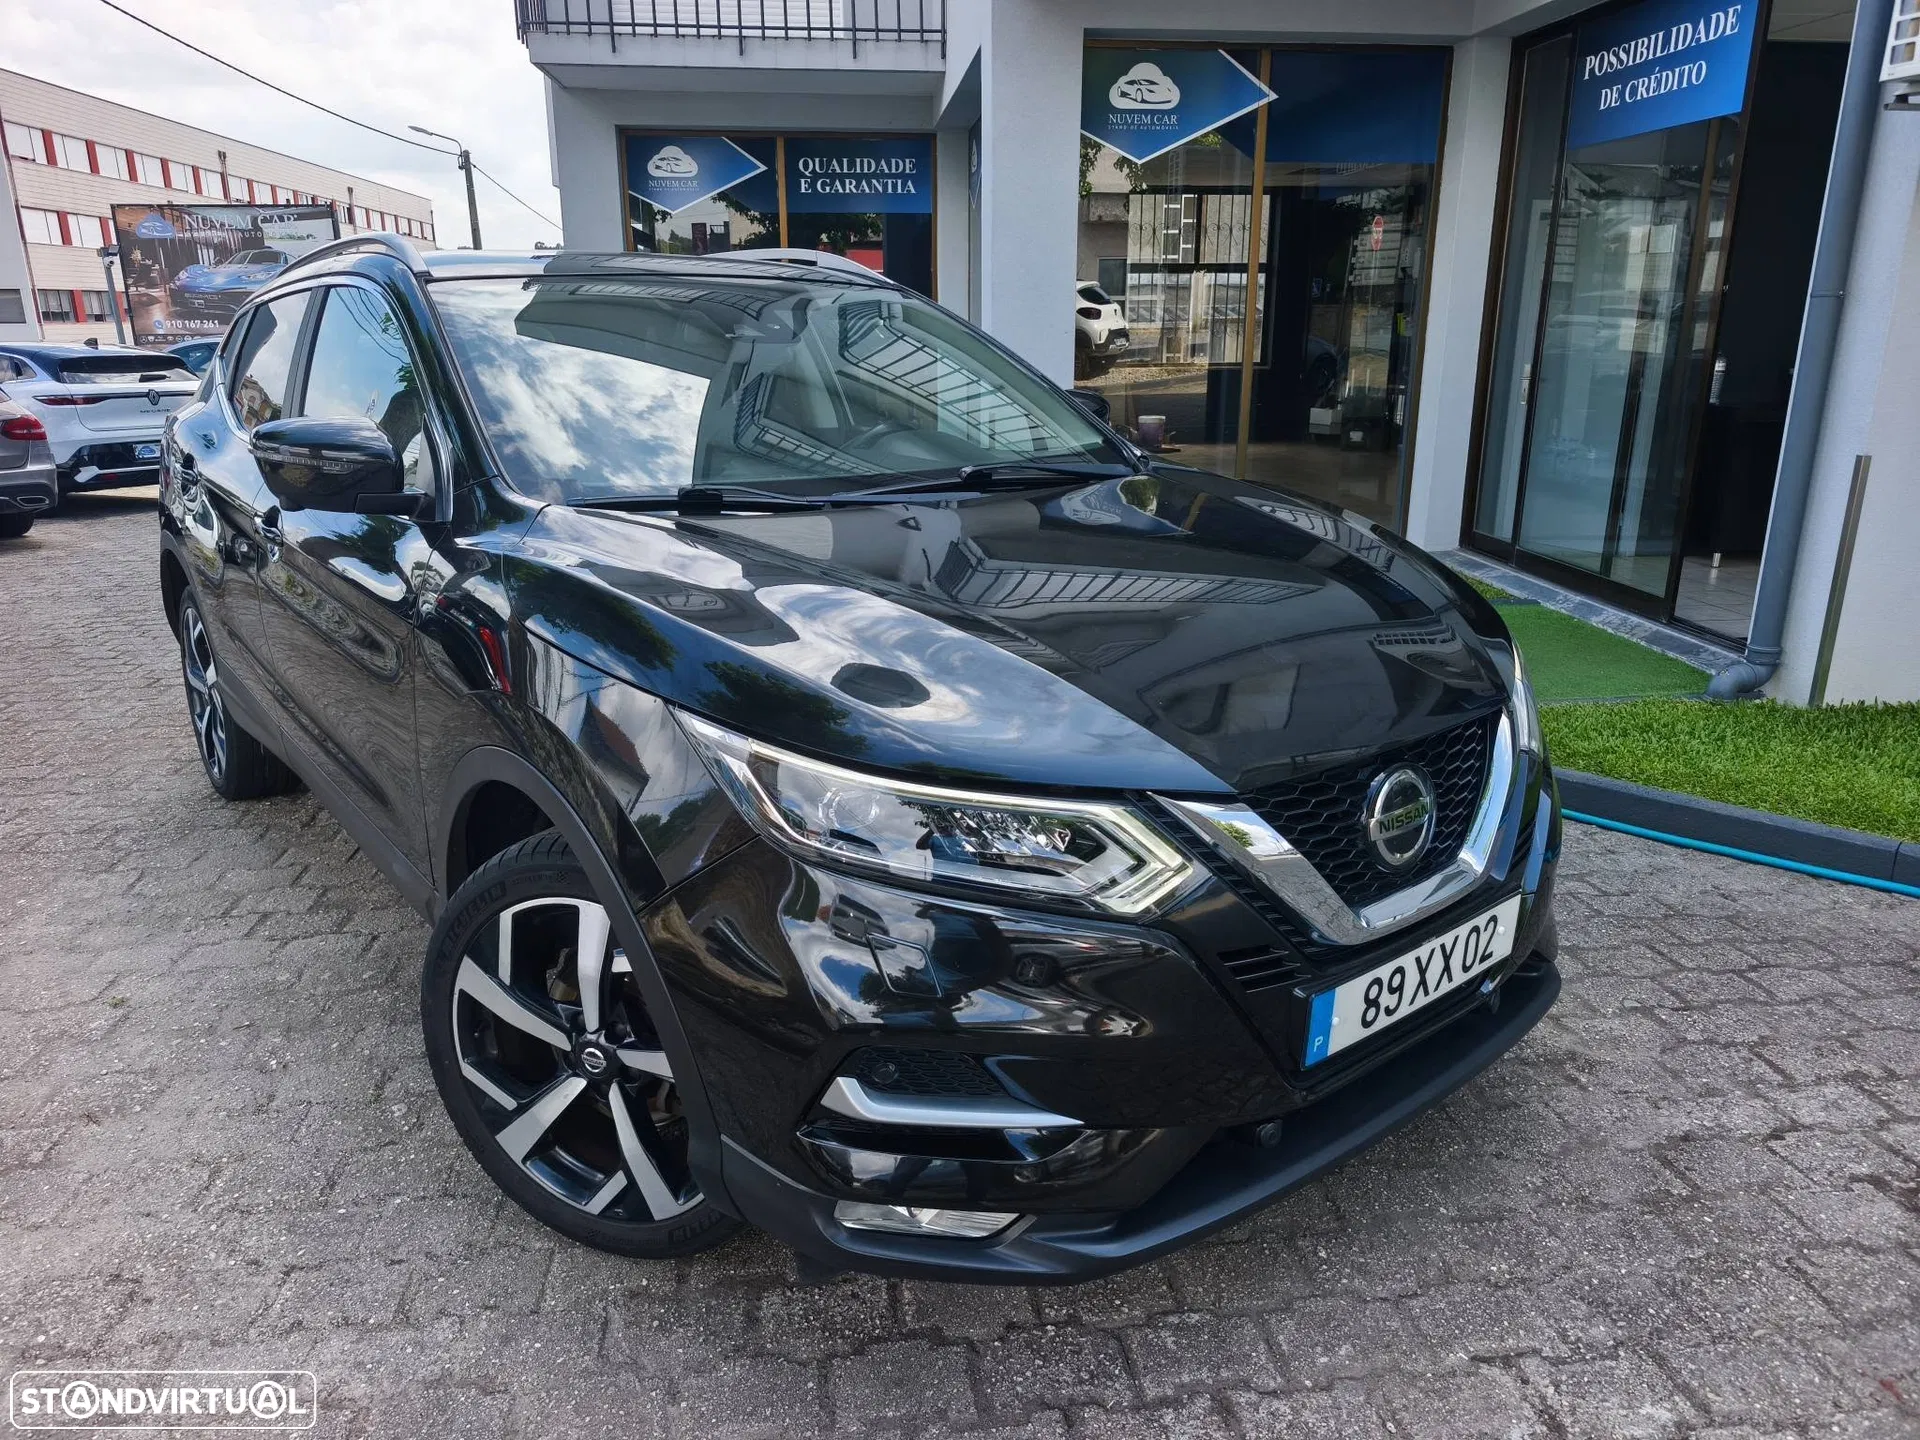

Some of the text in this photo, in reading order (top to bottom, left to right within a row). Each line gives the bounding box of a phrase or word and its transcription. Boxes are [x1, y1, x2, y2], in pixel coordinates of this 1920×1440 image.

[1583, 5, 1742, 80] POSSIBILIDADE
[1599, 60, 1708, 111] DE CRÉDITO
[1108, 113, 1178, 124] NUVEM CAR
[798, 156, 917, 177] QUALIDADE
[648, 179, 698, 187] NUVEM CAR
[799, 177, 917, 194] E GARANTIA
[183, 214, 254, 229] NUVEM
[165, 319, 219, 328] 910 167 261
[1377, 803, 1430, 834] NISSAN
[1313, 1035, 1324, 1053] P
